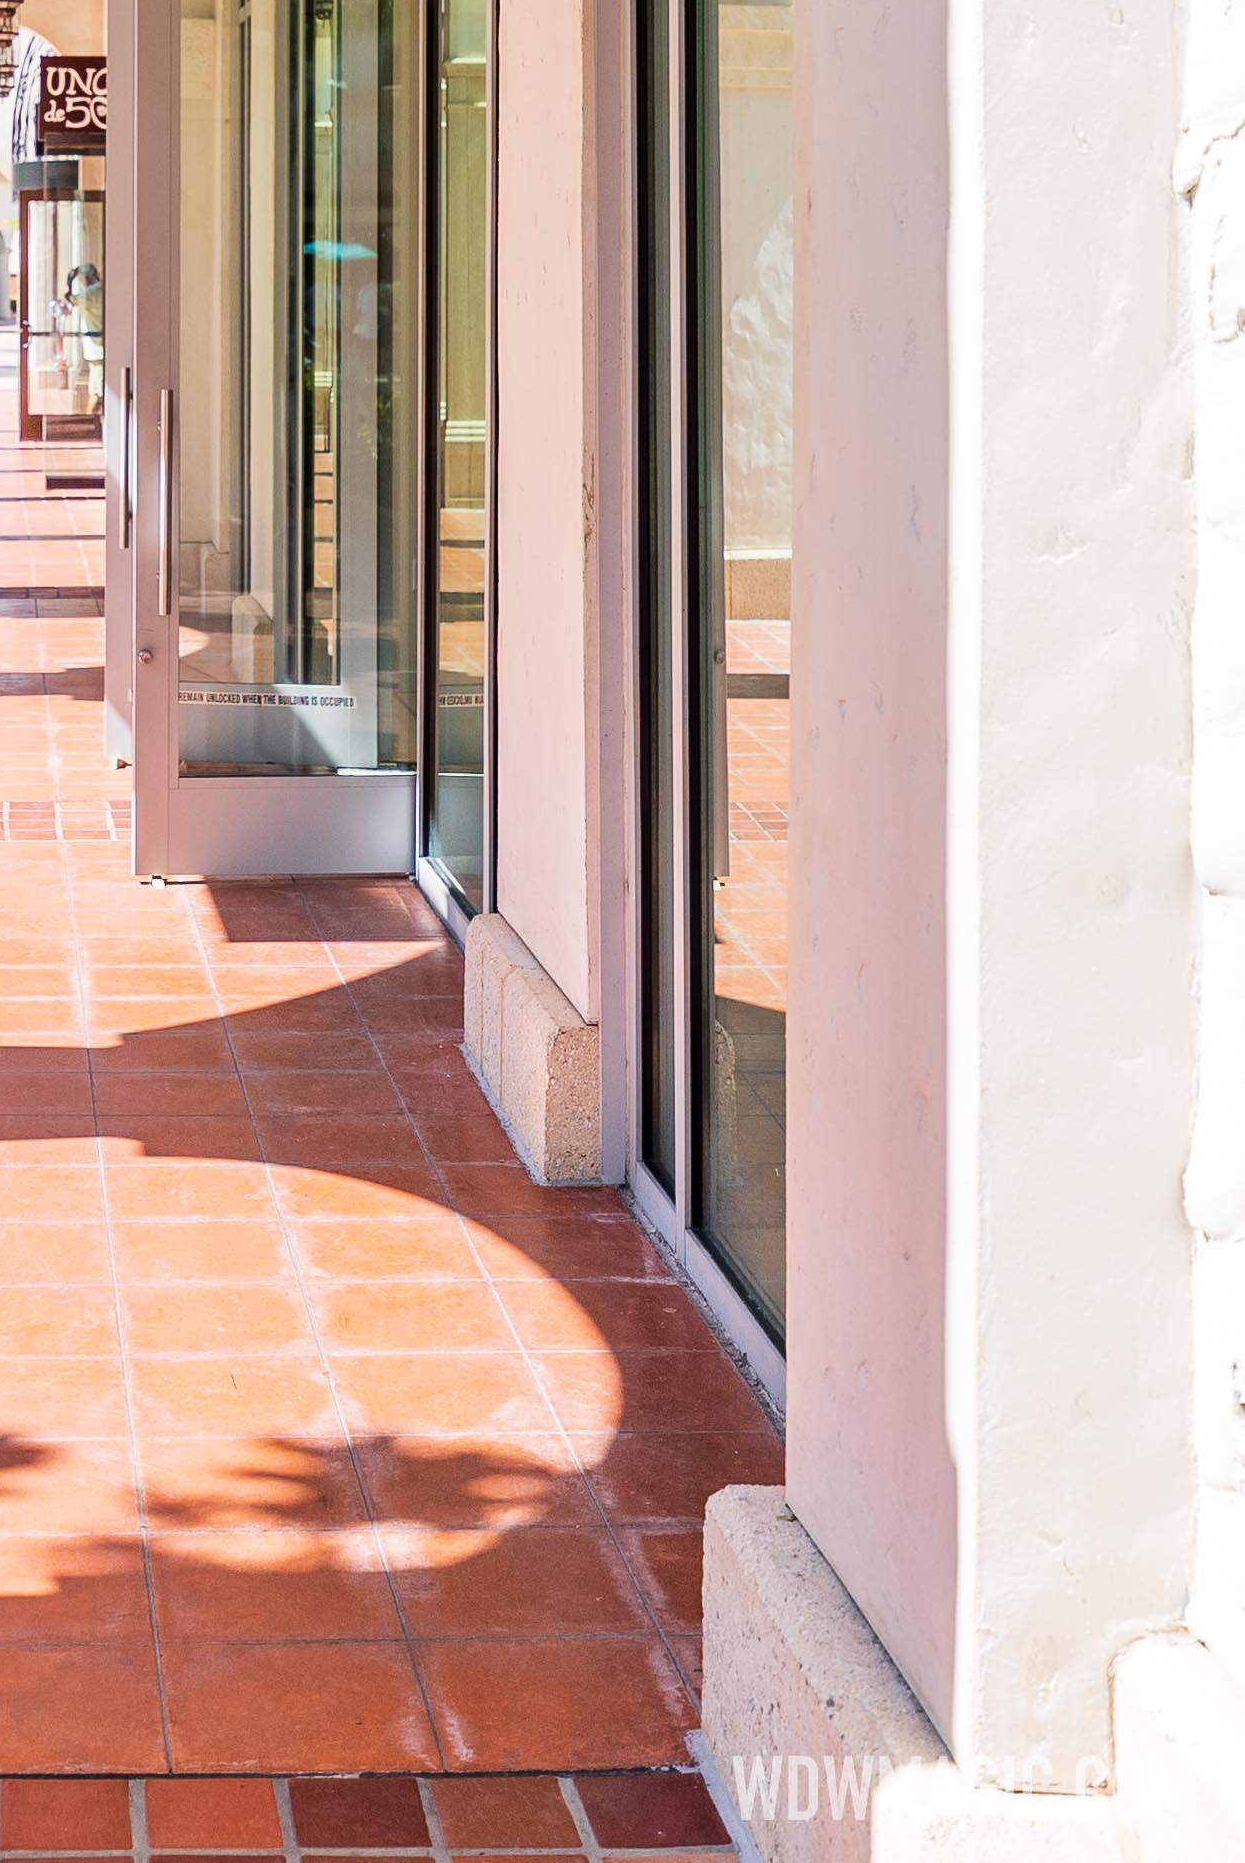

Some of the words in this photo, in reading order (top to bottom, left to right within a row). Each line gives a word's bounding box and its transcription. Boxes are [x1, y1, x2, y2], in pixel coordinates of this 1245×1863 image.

[179, 691, 204, 701] REMAIN
[206, 693, 241, 703] UNLOCKED
[242, 694, 262, 704] WHEN
[263, 695, 276, 705] THE
[278, 695, 309, 706] BUILDING
[311, 696, 318, 706] IS
[320, 696, 354, 707] OCCUPIED
